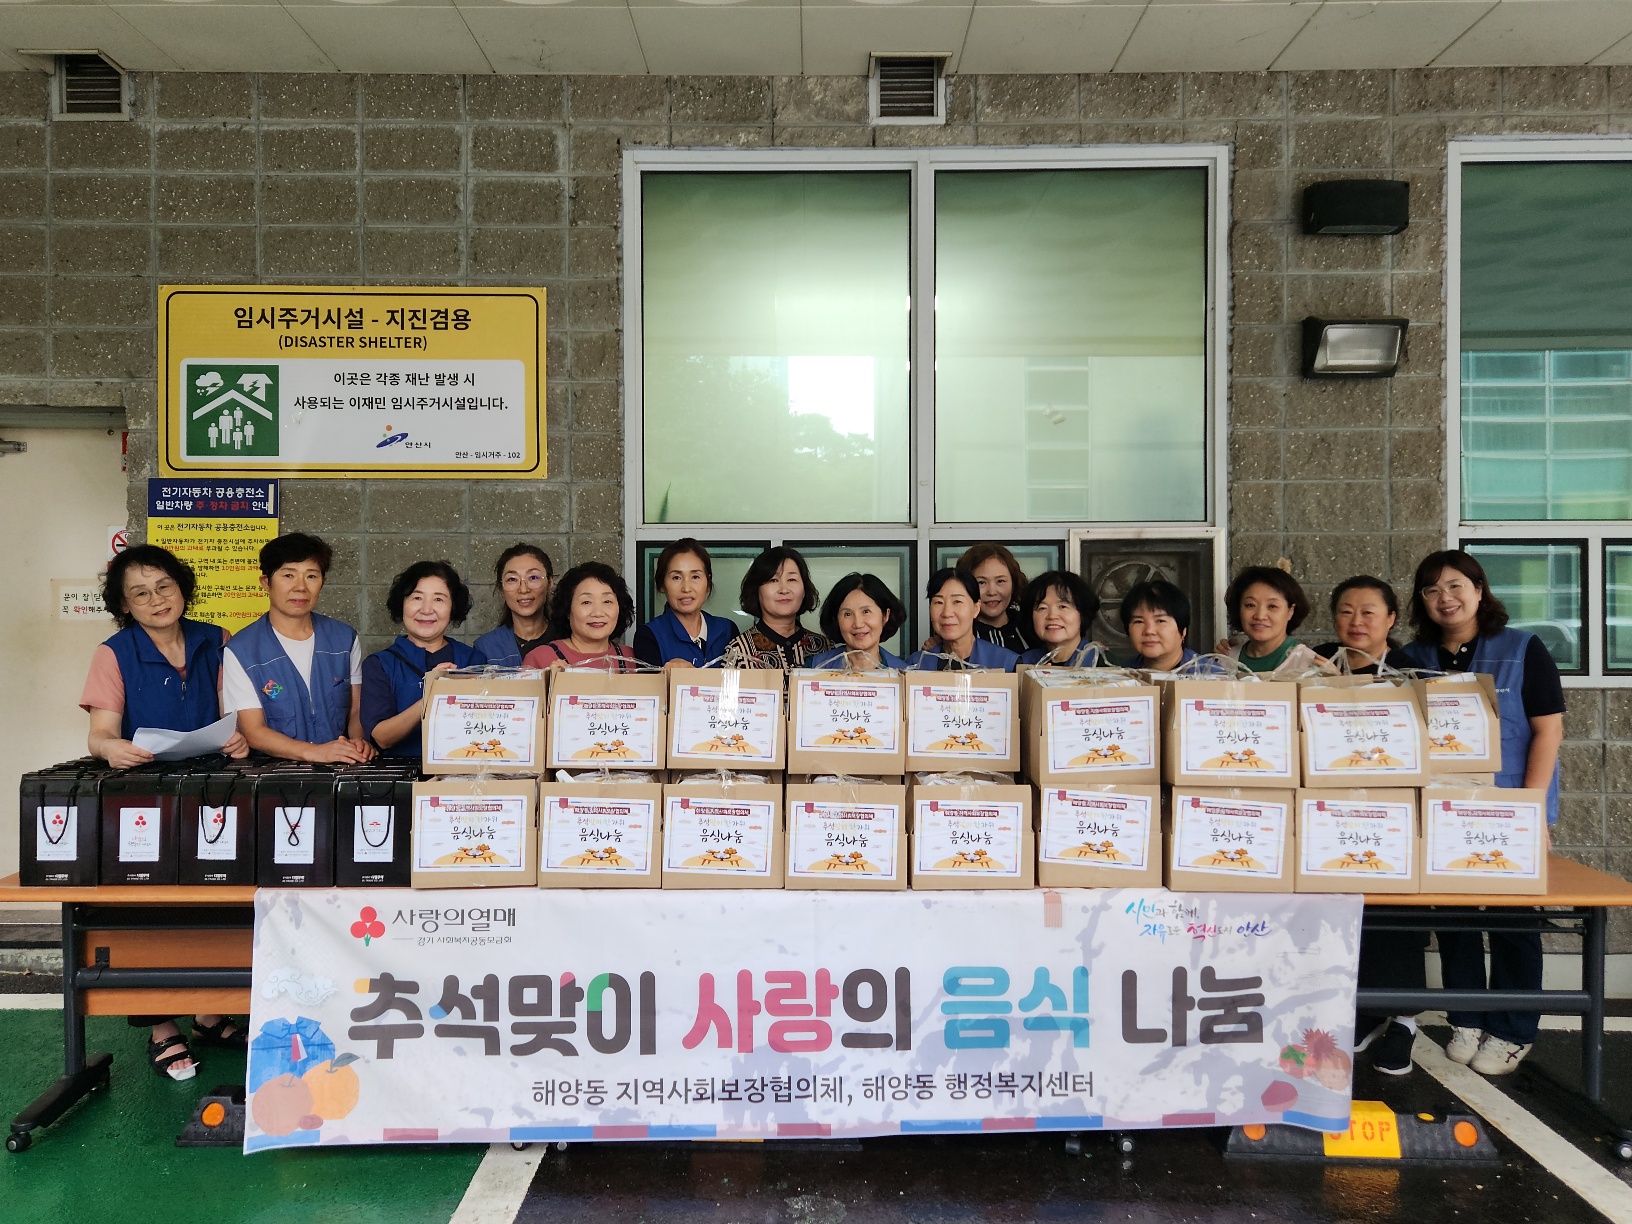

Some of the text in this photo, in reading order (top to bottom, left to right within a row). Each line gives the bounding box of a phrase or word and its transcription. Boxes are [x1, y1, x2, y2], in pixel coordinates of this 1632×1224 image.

[233, 306, 364, 330] 임시주거시설
[385, 308, 472, 331] 지진겸용
[278, 334, 428, 350] (DISASTER SHELTER)
[334, 372, 475, 387] 이곳은 각종 재난 발생 시
[294, 397, 508, 411] 사용되는 이재민 임시주거시설입니다.
[455, 451, 469, 459] 안산
[162, 487, 264, 498] 전기자동차 공용충전소
[156, 500, 193, 510] 일반차량
[177, 523, 212, 532] 전기자동차
[830, 708, 870, 723] 음식나눔
[941, 714, 983, 729] 음식나눔
[463, 721, 506, 735] 음식나눔
[587, 722, 629, 735] 음식나눔
[1428, 718, 1460, 730] 식나눔
[1082, 726, 1124, 741] 음식나눔
[1216, 730, 1260, 744] 음식나눔
[1343, 728, 1390, 742] 음식나눔
[450, 825, 495, 840] 음식나눔
[578, 827, 622, 843] 음식나눔
[699, 828, 743, 844] 음식나눔
[1076, 820, 1119, 837] 음식나눔
[1210, 828, 1254, 844] 음식나눔
[825, 832, 868, 847] 음식나눔
[950, 830, 992, 845] 음식나눔
[1337, 831, 1382, 846] 음식나눔
[1463, 830, 1509, 846] 음식나눔
[1125, 898, 1168, 924] 시민과
[392, 908, 517, 934] 사랑의열매
[1139, 921, 1273, 944] 자유로운 혁신도시 안산
[417, 935, 513, 946] 경기 사회복지공동모금회
[348, 966, 1265, 1059] 추석맞이 사랑의 음식 나눔
[532, 1071, 1094, 1106] 해양동 지역사회보장협의체, 해양동 행정복지센터
